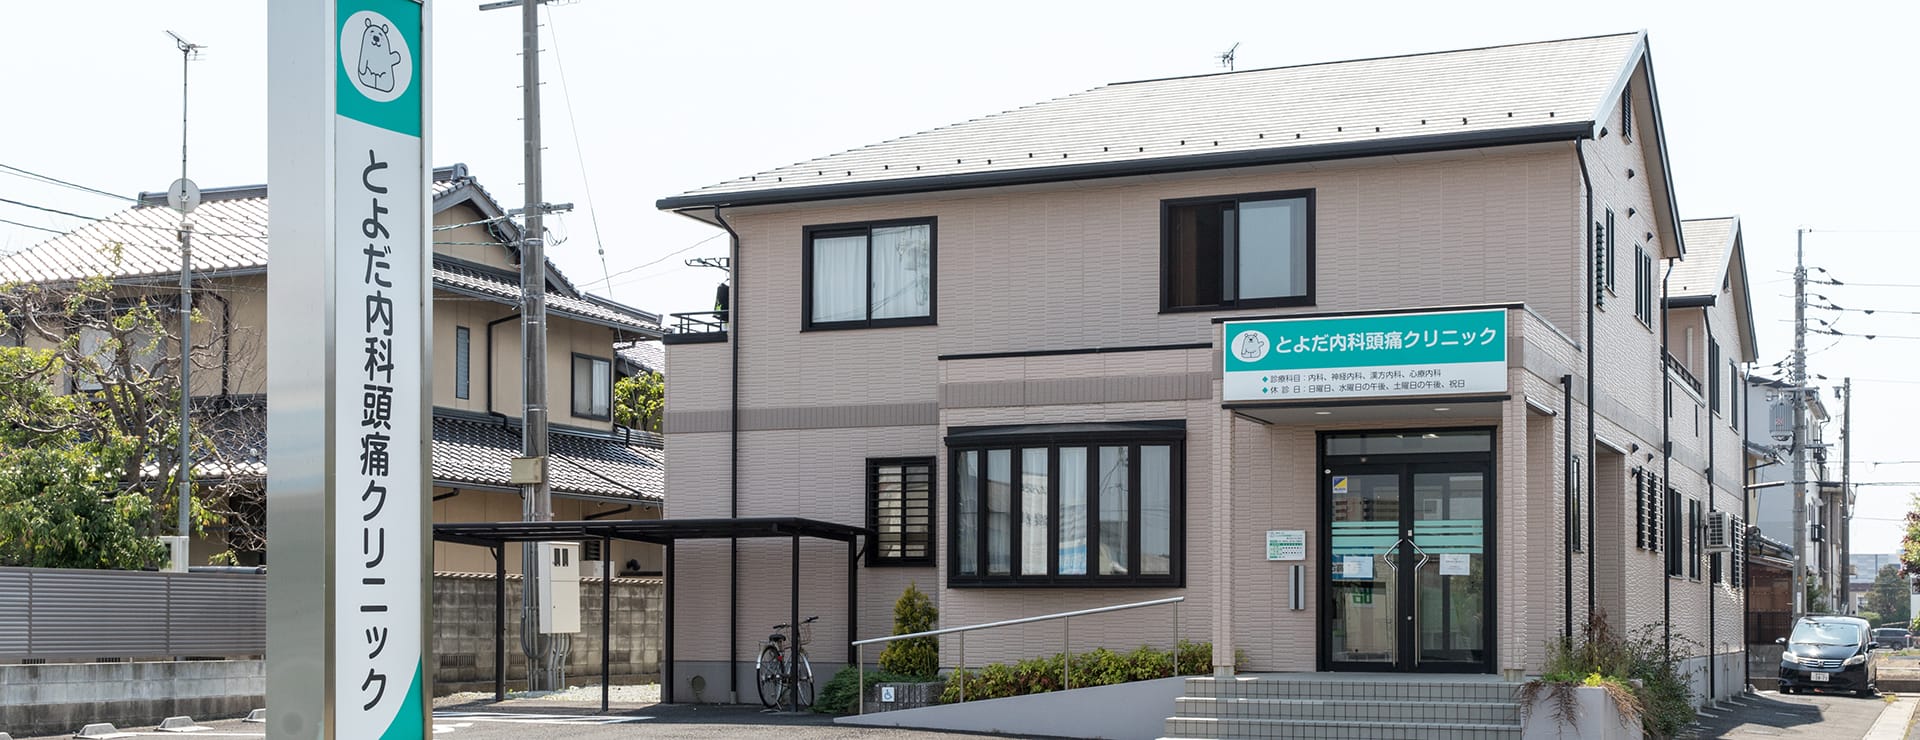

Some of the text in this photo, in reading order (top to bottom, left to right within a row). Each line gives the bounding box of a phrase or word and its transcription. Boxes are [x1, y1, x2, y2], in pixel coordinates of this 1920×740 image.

[360, 149, 394, 711] とよだ内科頭痛クリニック
[1276, 327, 1497, 353] とよだ内科頭痛クリニック
